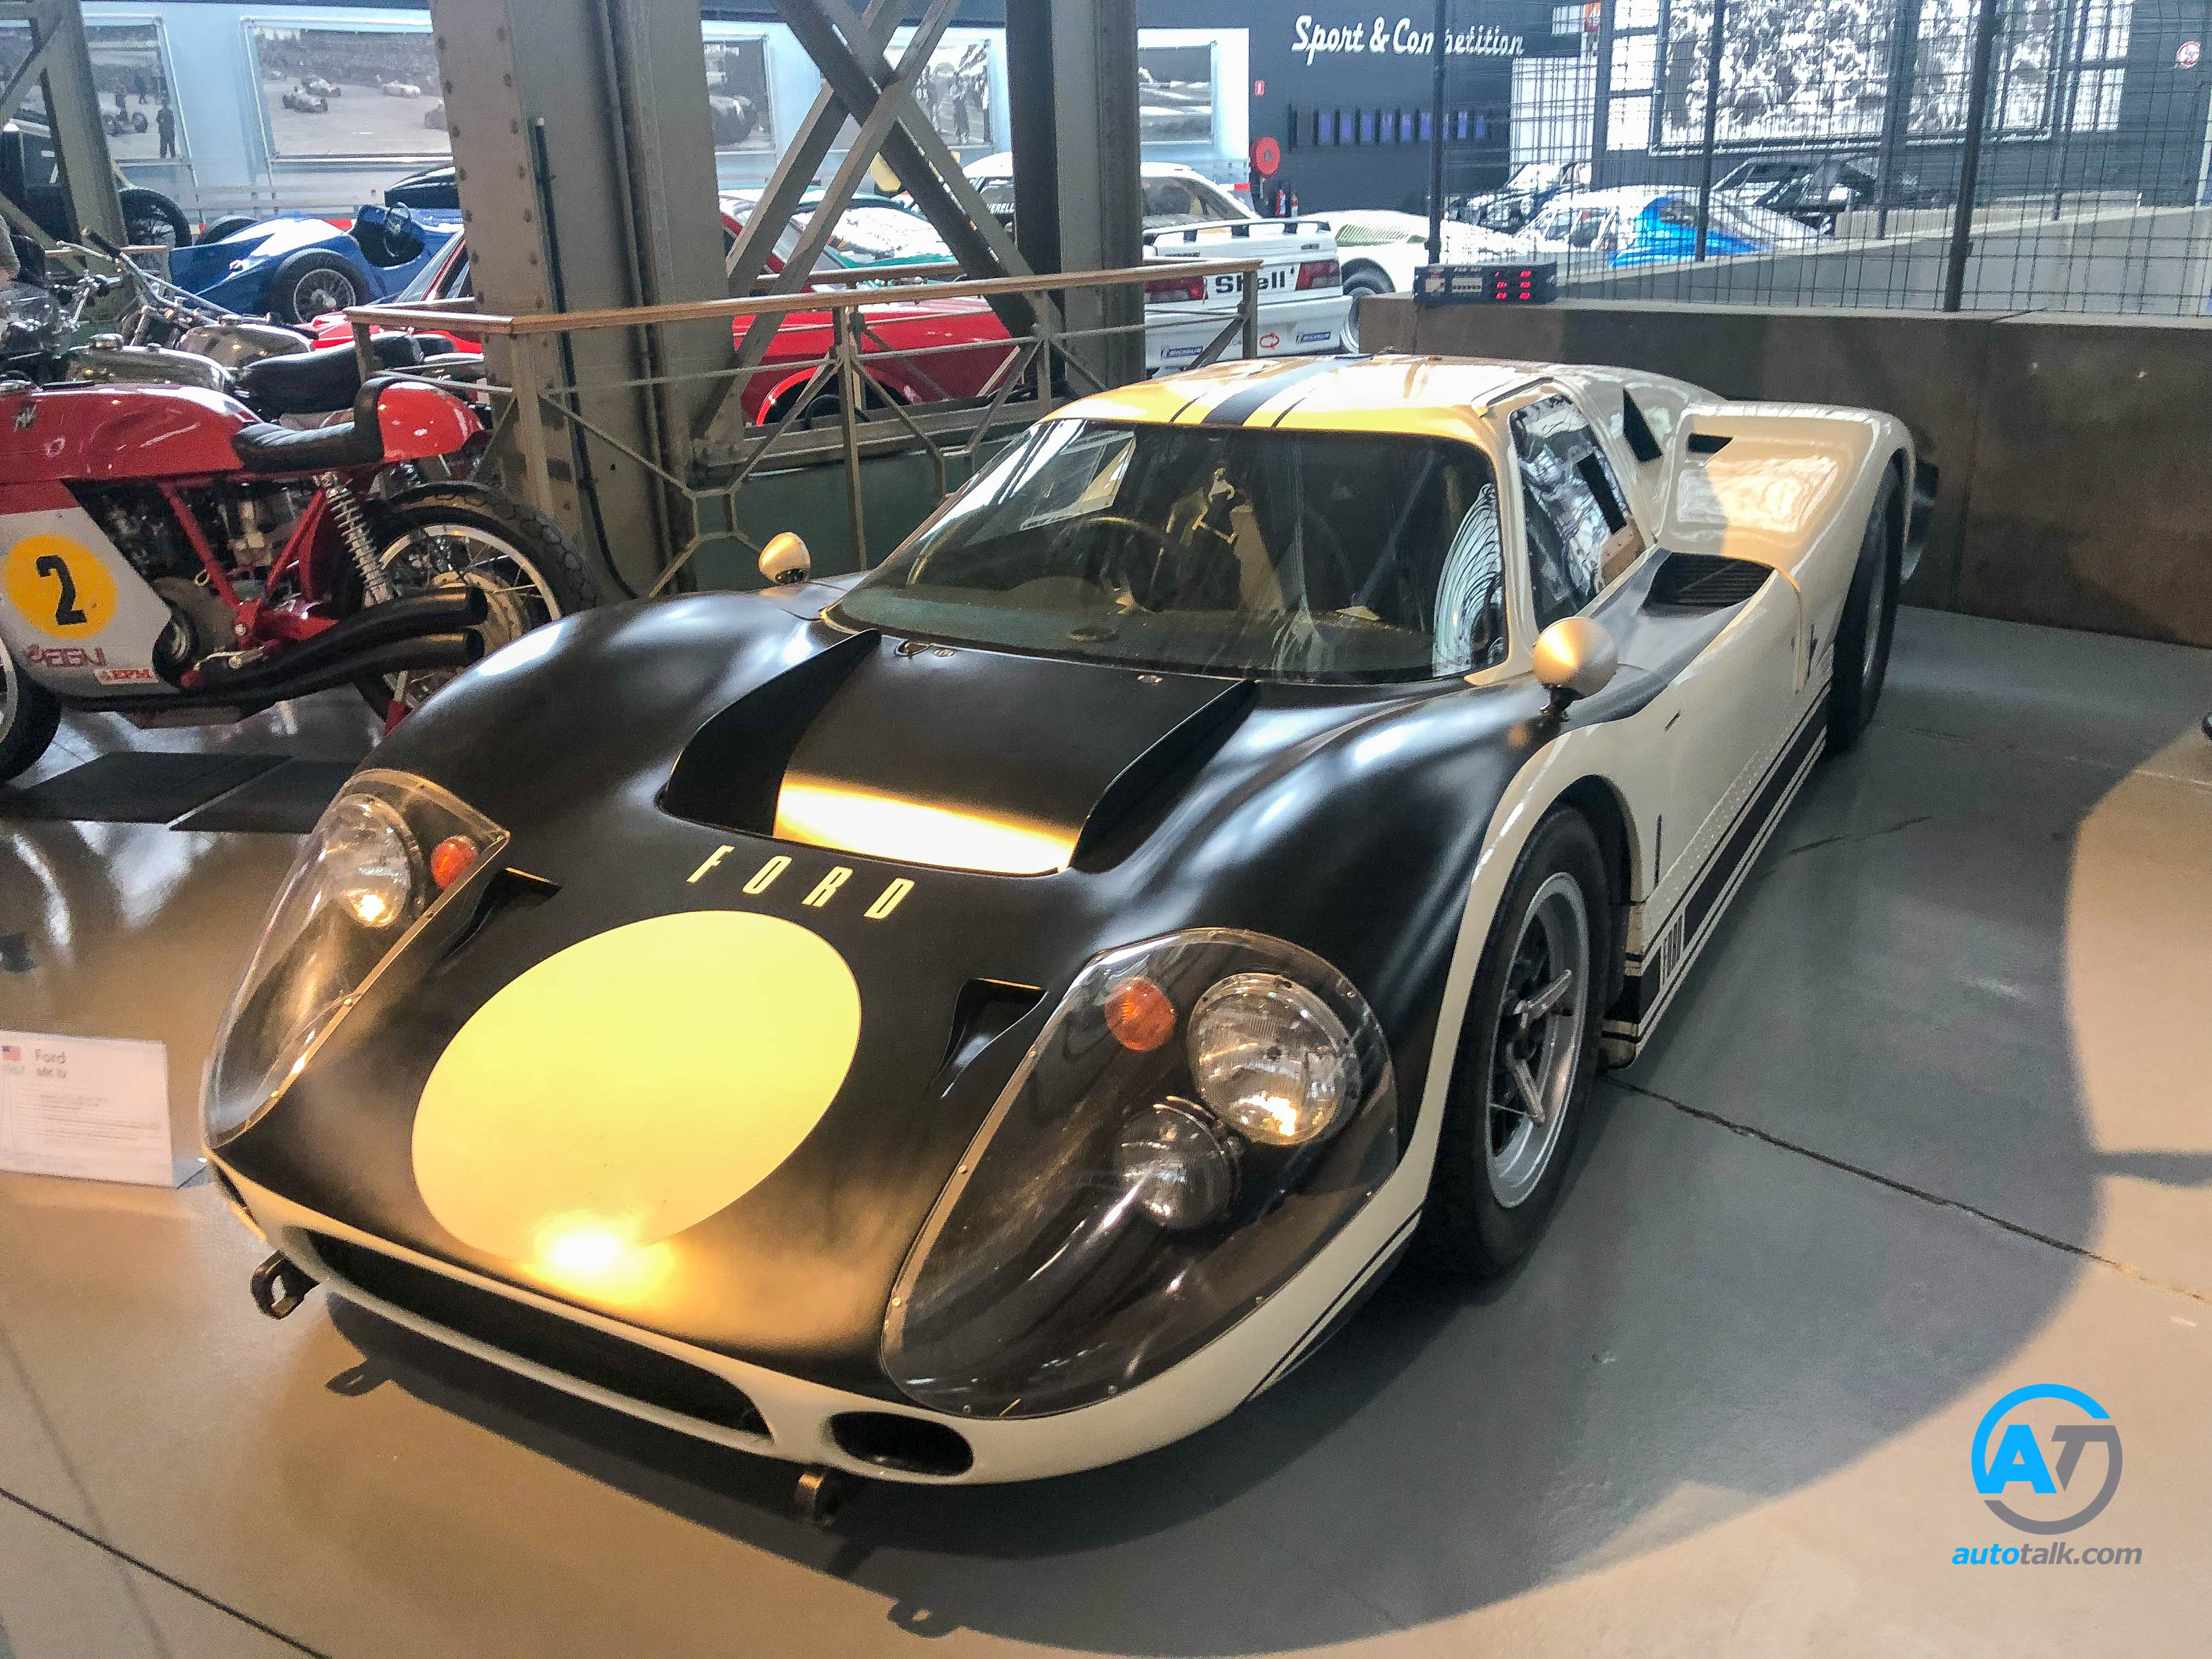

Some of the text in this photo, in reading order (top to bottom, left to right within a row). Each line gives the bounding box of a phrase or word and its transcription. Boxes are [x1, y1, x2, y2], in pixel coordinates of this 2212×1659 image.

[1291, 14, 1365, 66] Sport
[1369, 16, 1391, 54] &
[36, 555, 88, 626] 2
[686, 844, 915, 920] FORD
